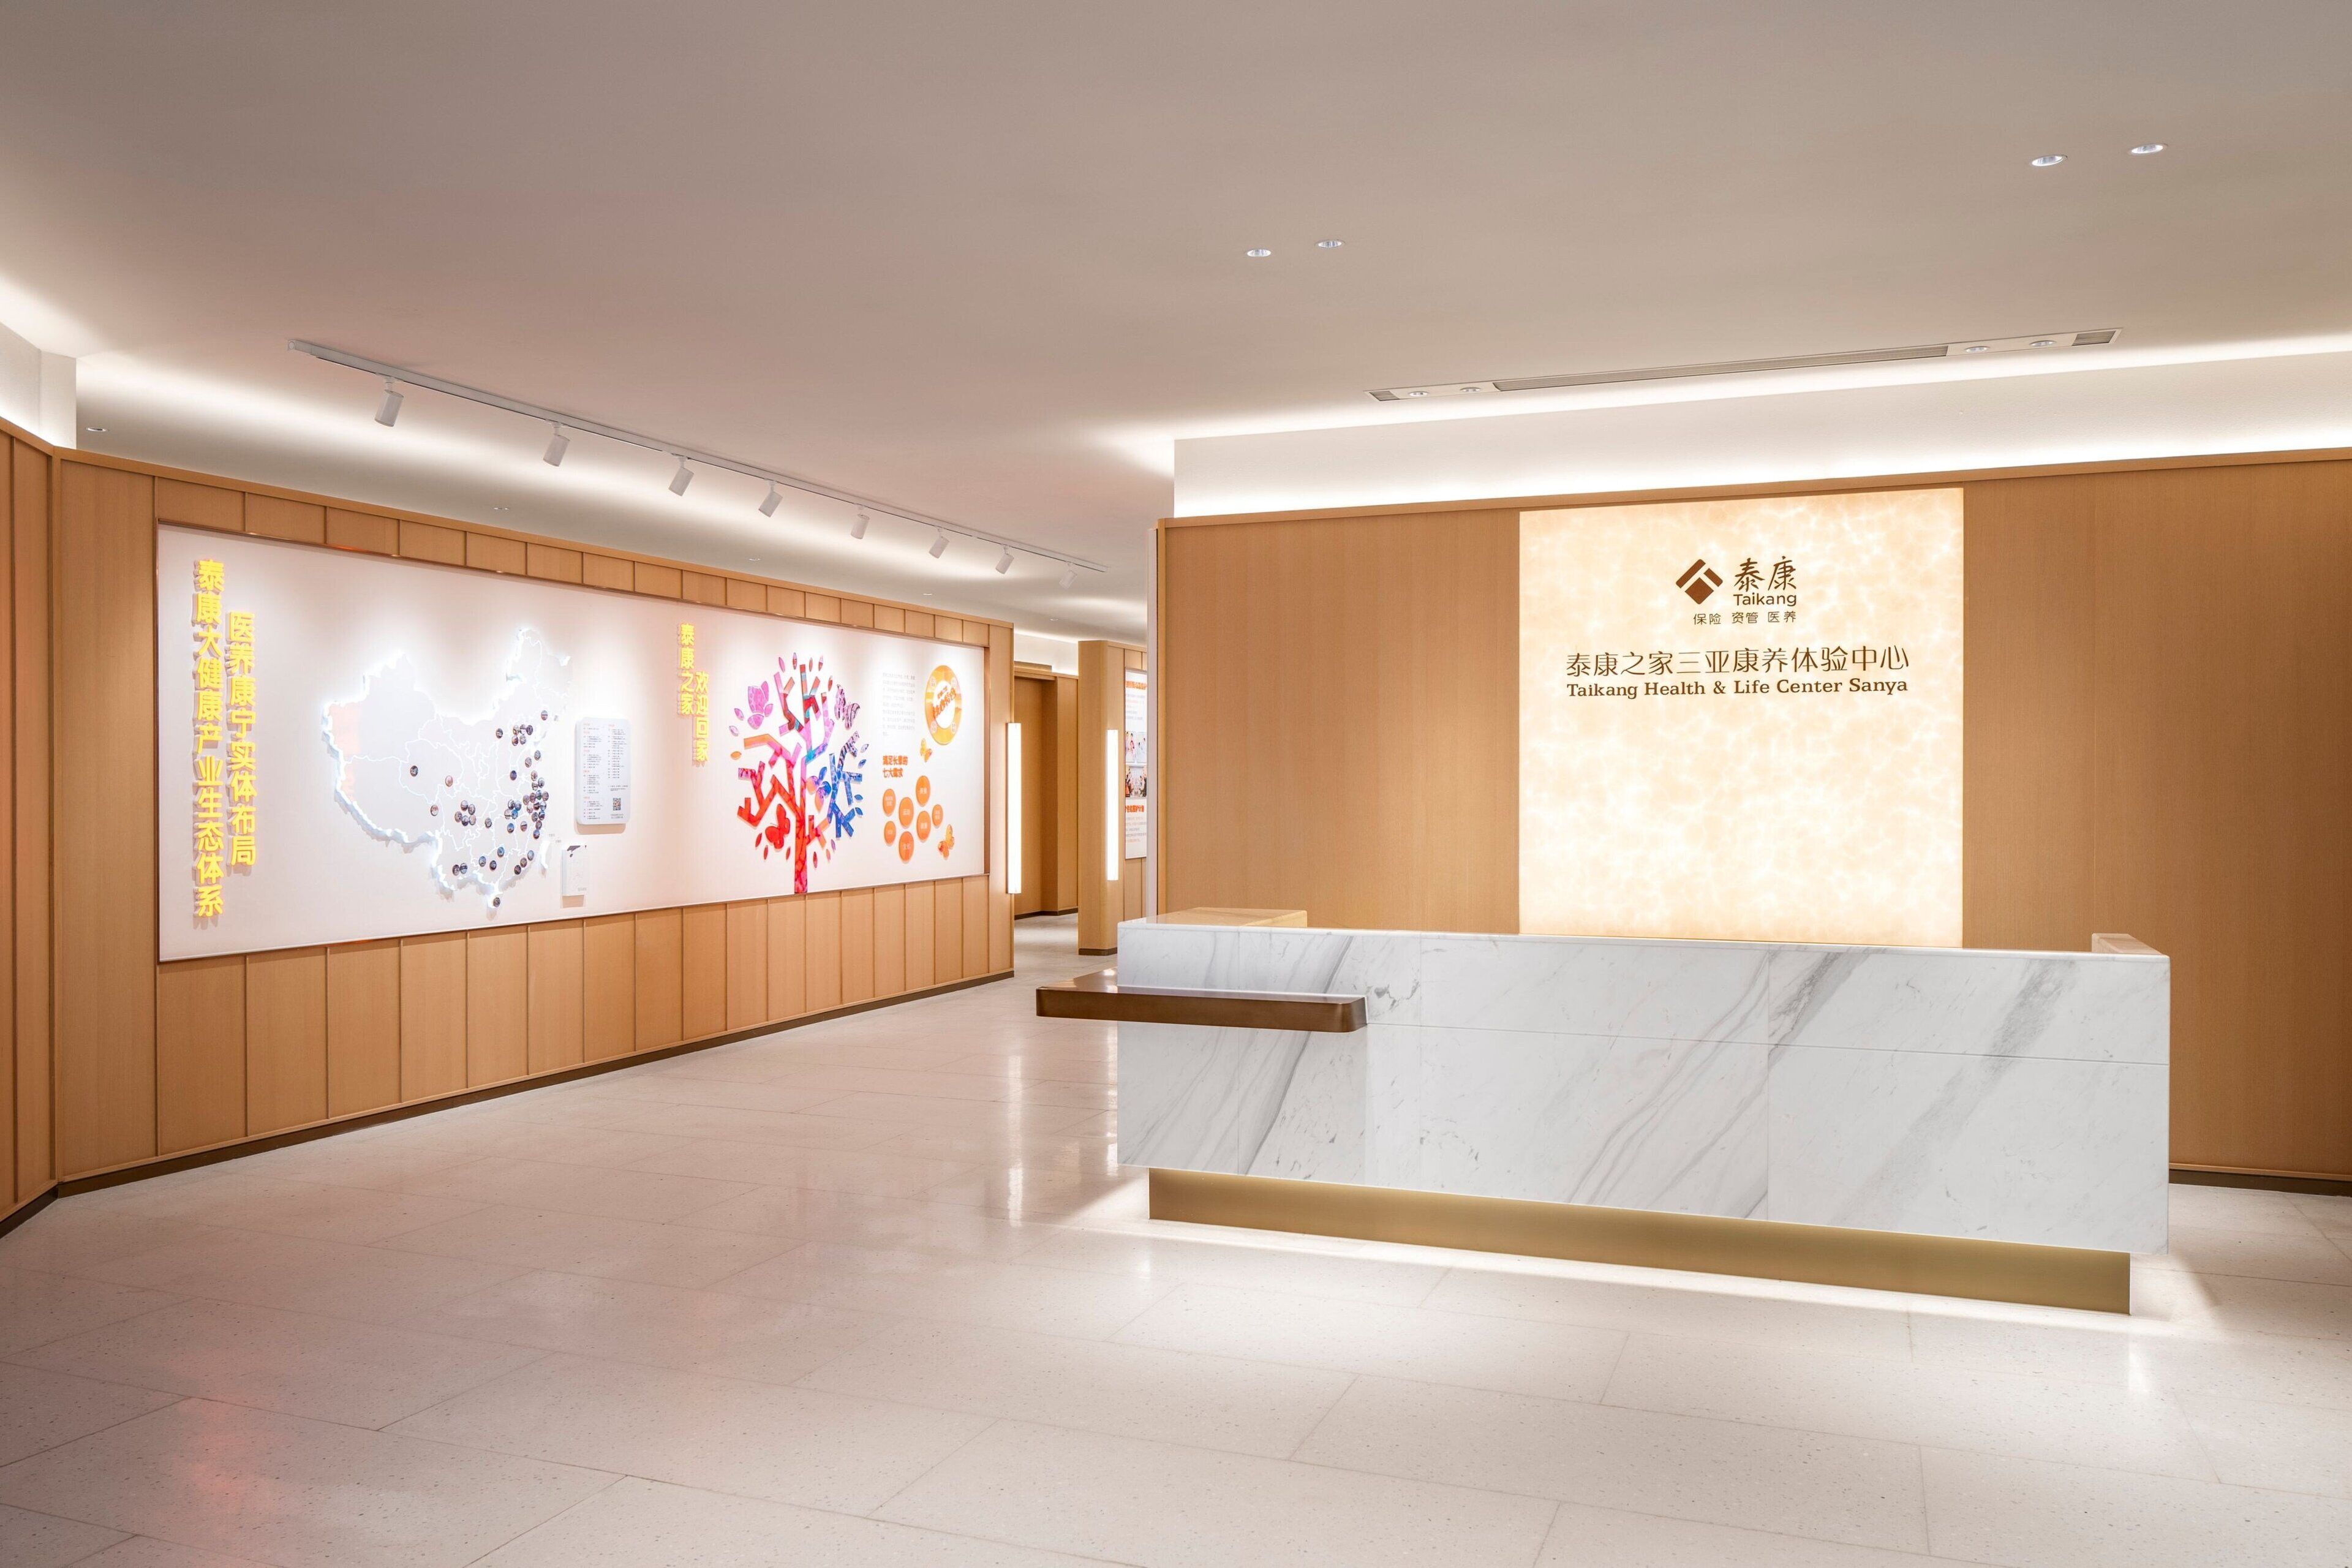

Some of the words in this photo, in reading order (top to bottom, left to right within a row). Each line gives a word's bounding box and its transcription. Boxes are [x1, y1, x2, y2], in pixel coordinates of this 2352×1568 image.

[1733, 556, 1796, 592] 泰康
[1733, 592, 1796, 607] Taikang
[1693, 613, 1721, 625] 保险
[1732, 611, 1758, 624] 资管
[1768, 611, 1796, 623] 医养
[679, 624, 695, 715] 泰康之家
[1566, 645, 1909, 677] 泰康之家三亚康养体验中心
[1567, 683, 1638, 699] Taikang
[1644, 681, 1706, 696] Health
[1713, 680, 1726, 695] &
[1734, 679, 1770, 694] Life
[1776, 679, 1843, 693] Center
[1849, 677, 1908, 695] Sanya
[695, 671, 709, 761] 欢迎回家
[195, 559, 224, 917] 泰康大健康产业生态体系
[229, 612, 257, 865] 医养康宁实体布局
